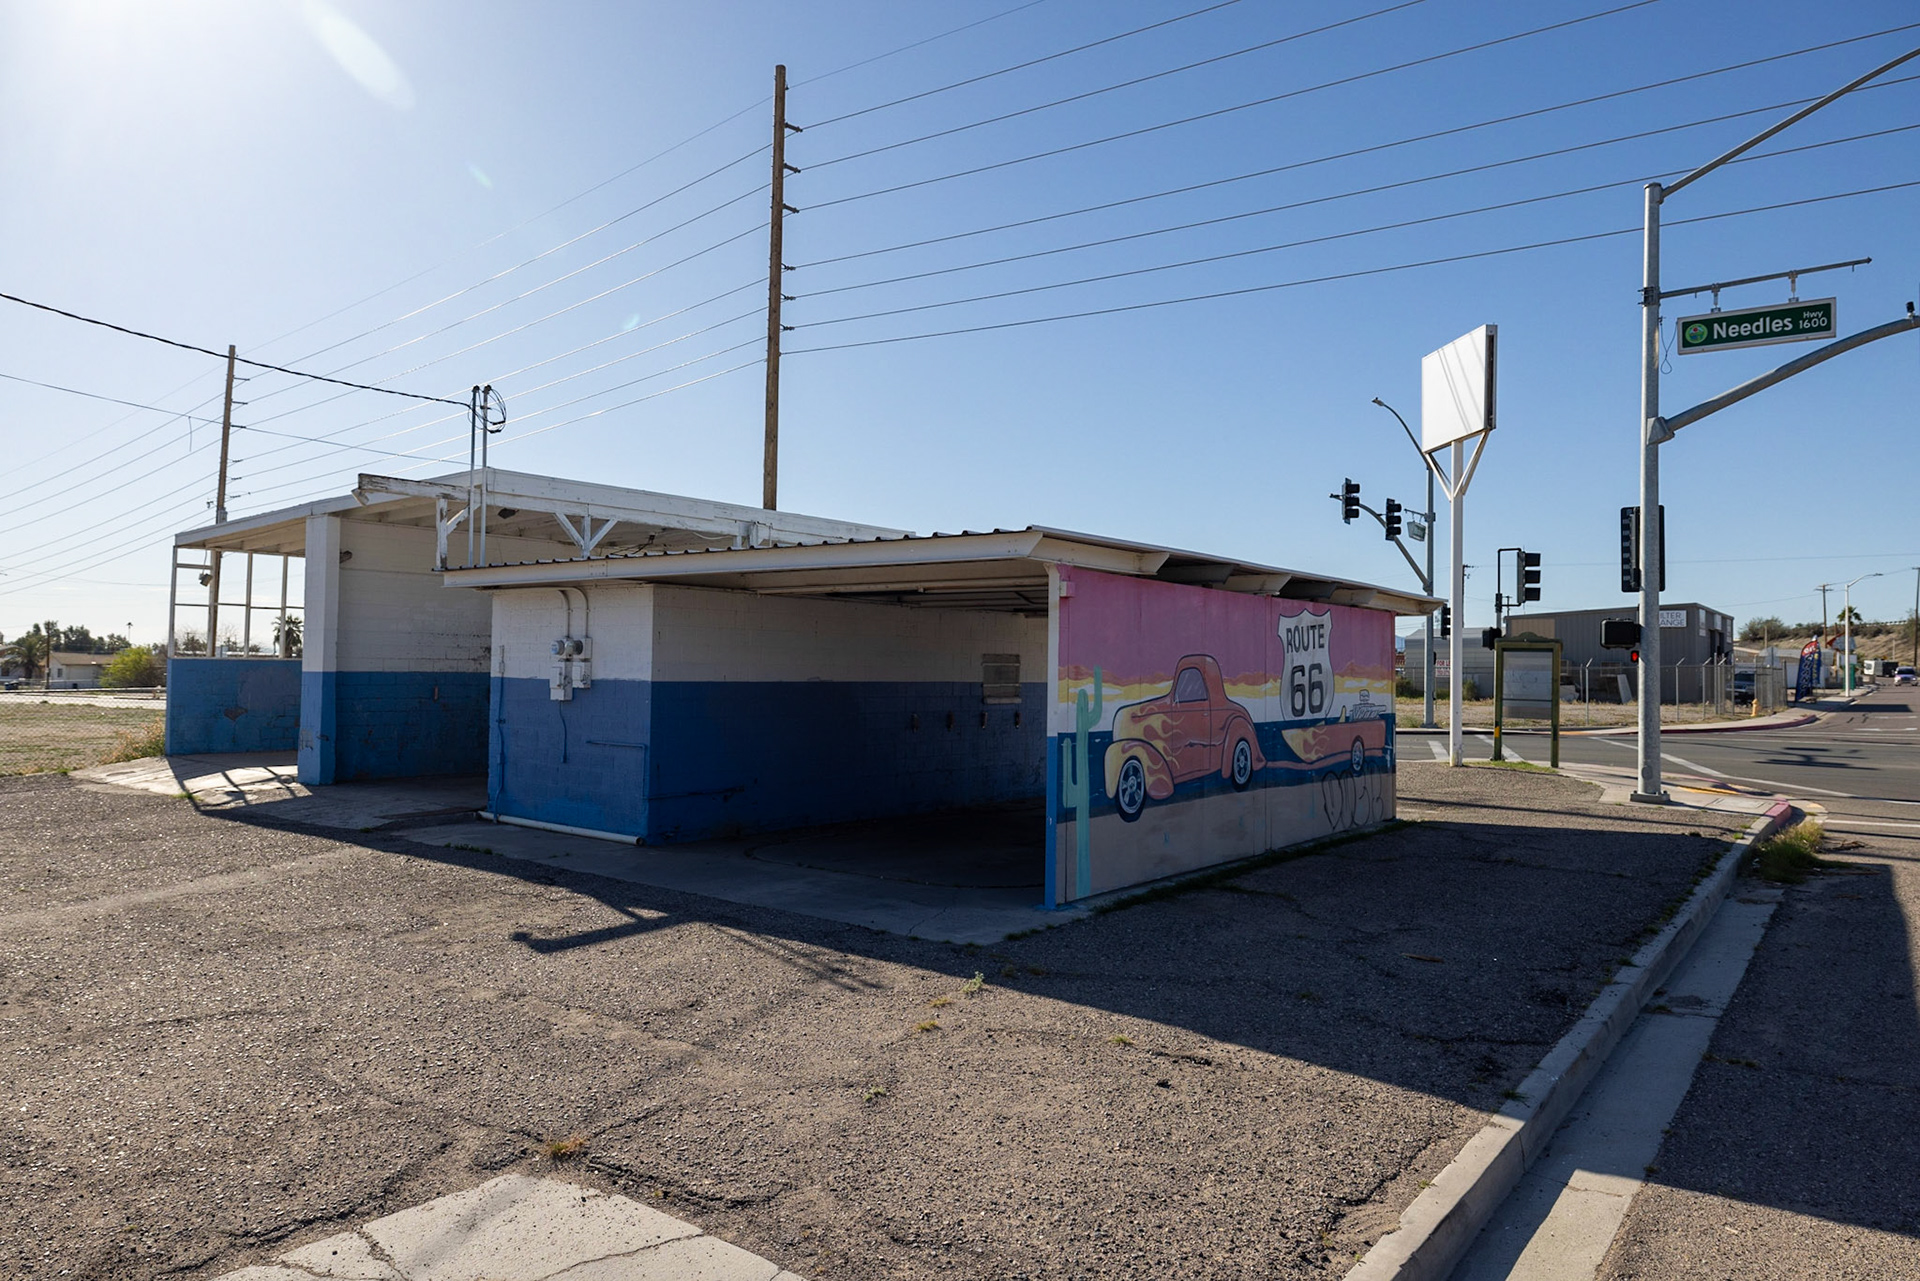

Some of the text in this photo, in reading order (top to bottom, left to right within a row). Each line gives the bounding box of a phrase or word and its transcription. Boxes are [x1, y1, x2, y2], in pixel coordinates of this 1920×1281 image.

[1799, 316, 1827, 329] 1600
[1803, 311, 1823, 320] Hwy
[1713, 316, 1793, 339] Needles
[1286, 624, 1325, 654] ROUTE
[1290, 663, 1324, 717] 66
